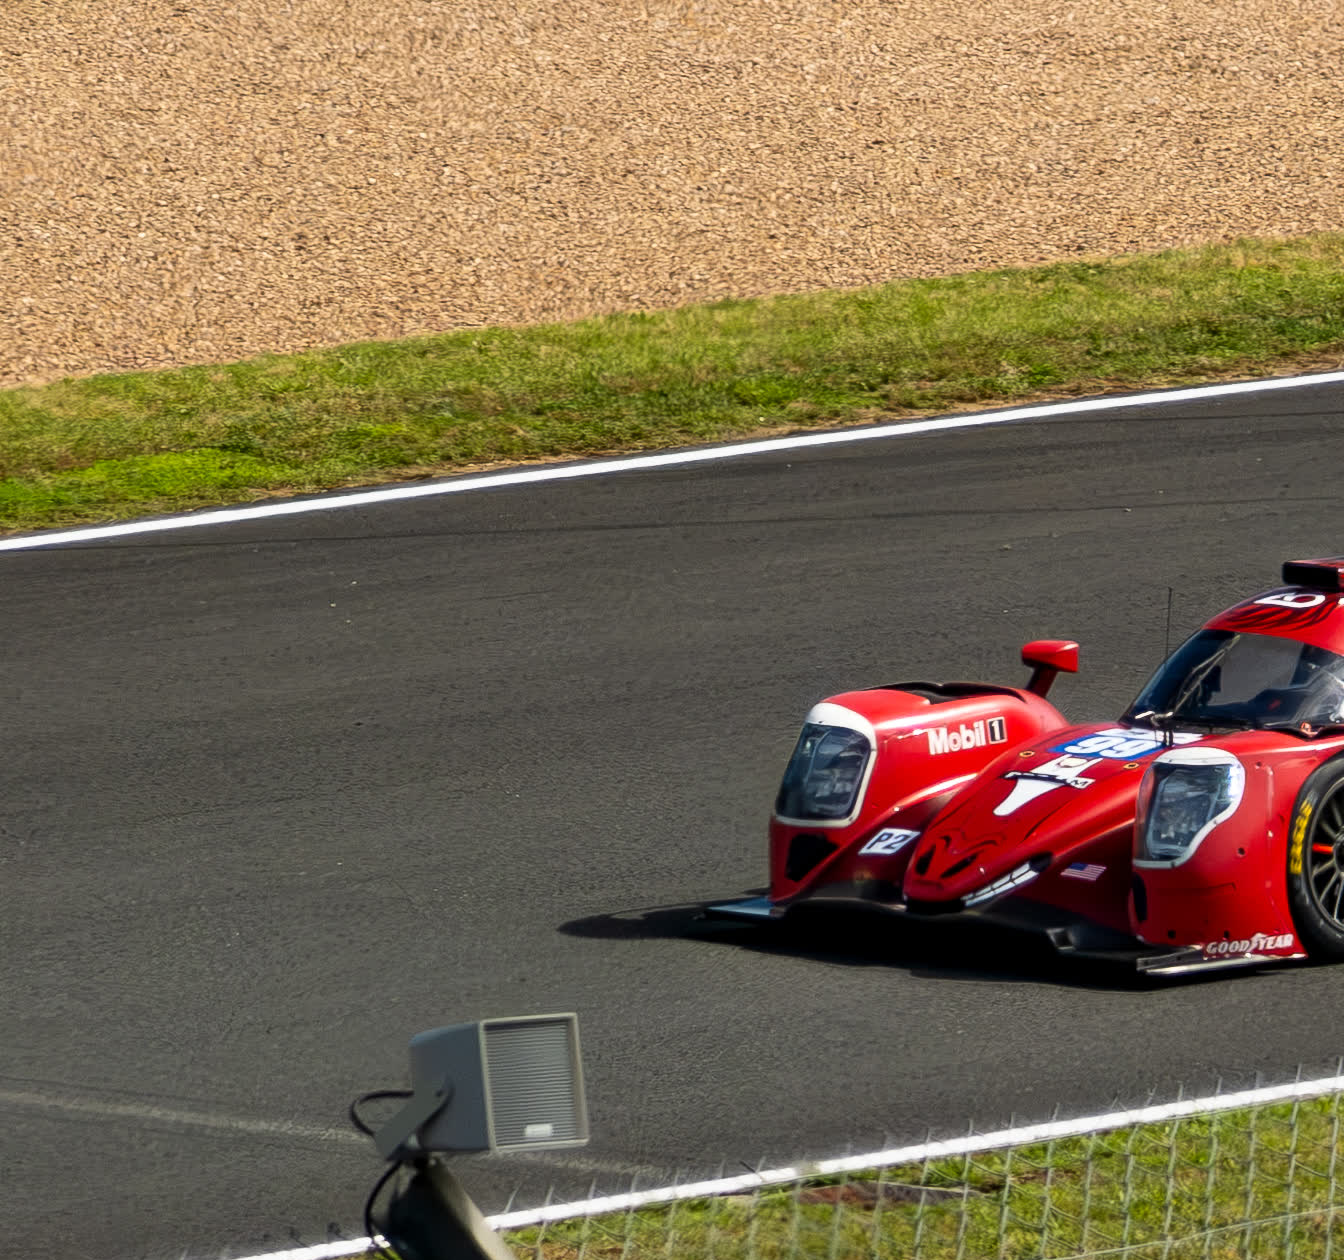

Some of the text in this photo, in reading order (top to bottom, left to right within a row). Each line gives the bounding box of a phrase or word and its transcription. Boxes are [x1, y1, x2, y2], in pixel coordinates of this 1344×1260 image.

[927, 720, 987, 756] Mobil
[1064, 735, 1162, 758] 99
[866, 832, 912, 850] P2
[1206, 932, 1294, 954] GOODYEAR
